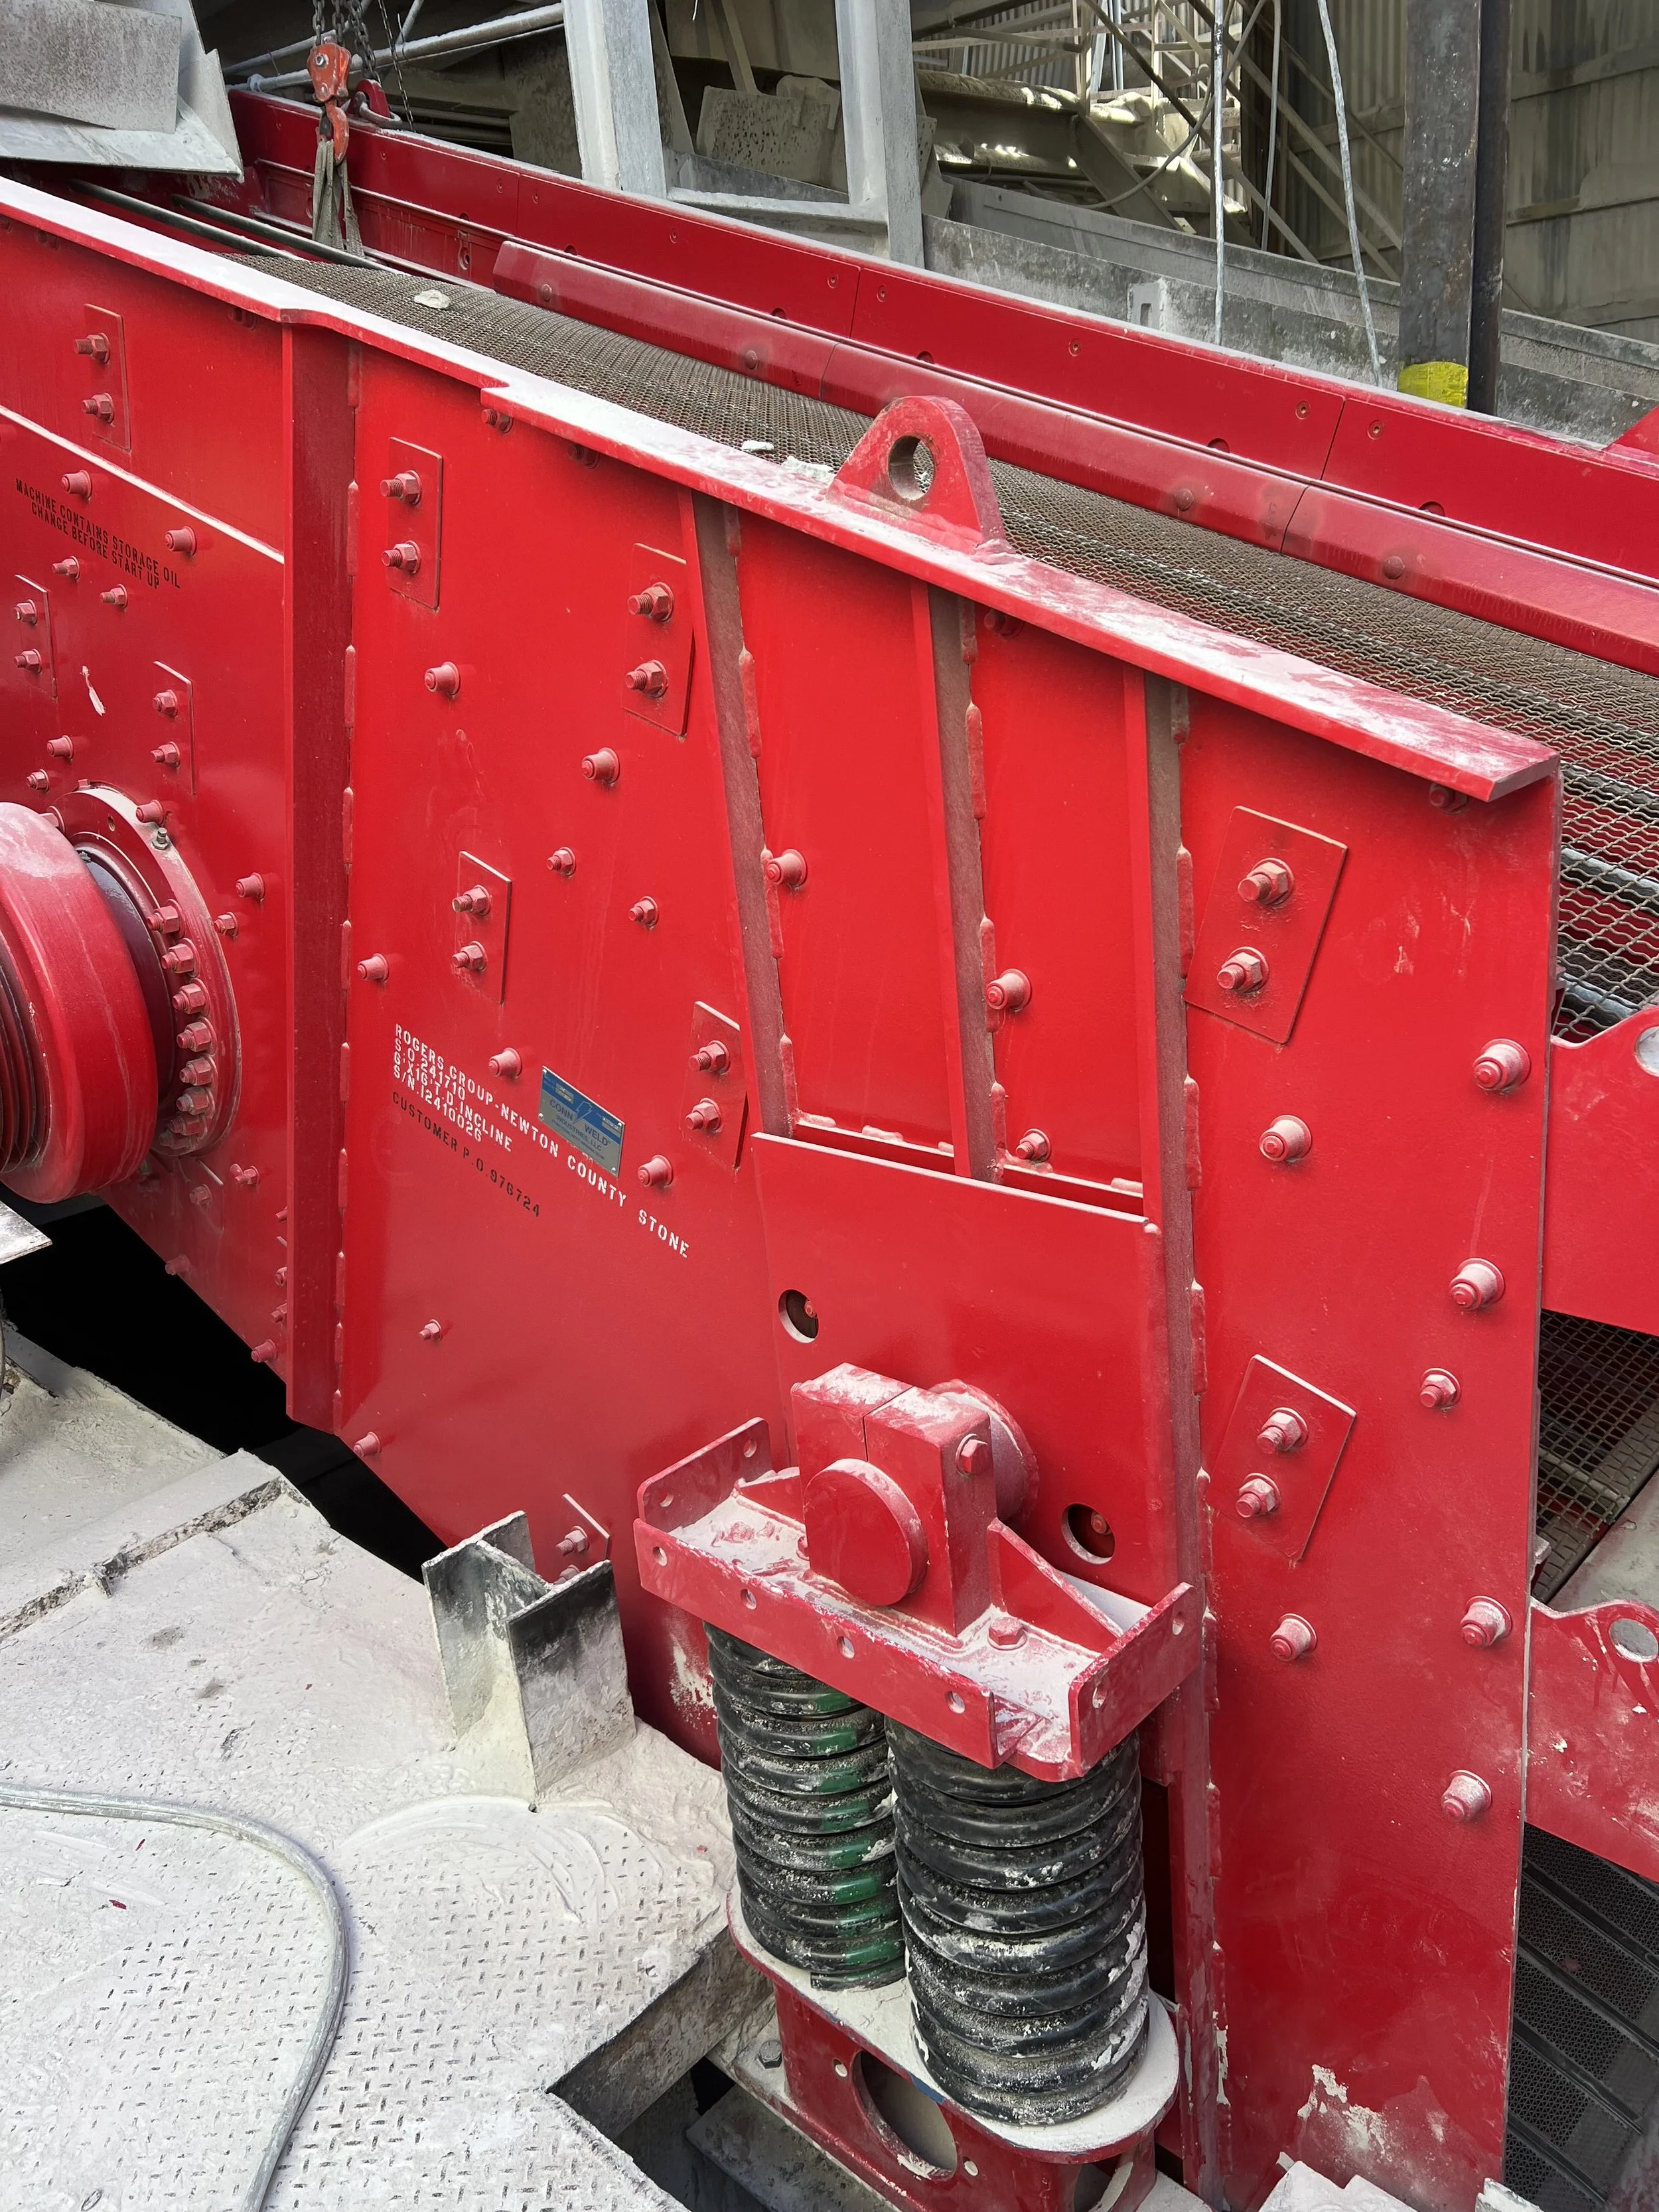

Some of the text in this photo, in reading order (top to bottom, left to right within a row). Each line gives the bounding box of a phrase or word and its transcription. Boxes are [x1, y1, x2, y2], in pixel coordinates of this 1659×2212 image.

[16, 478, 180, 589] MACHINE CONTAINS STORAGE OIL
[31, 502, 160, 589] CHANGE BEFORE START UP
[392, 1092, 458, 1152] CUSTOMER
[396, 1023, 445, 1070] ROGERS
[567, 1155, 626, 1207] COUNTY
[638, 1209, 689, 1258] STONE
[549, 1099, 574, 1122] CONN
